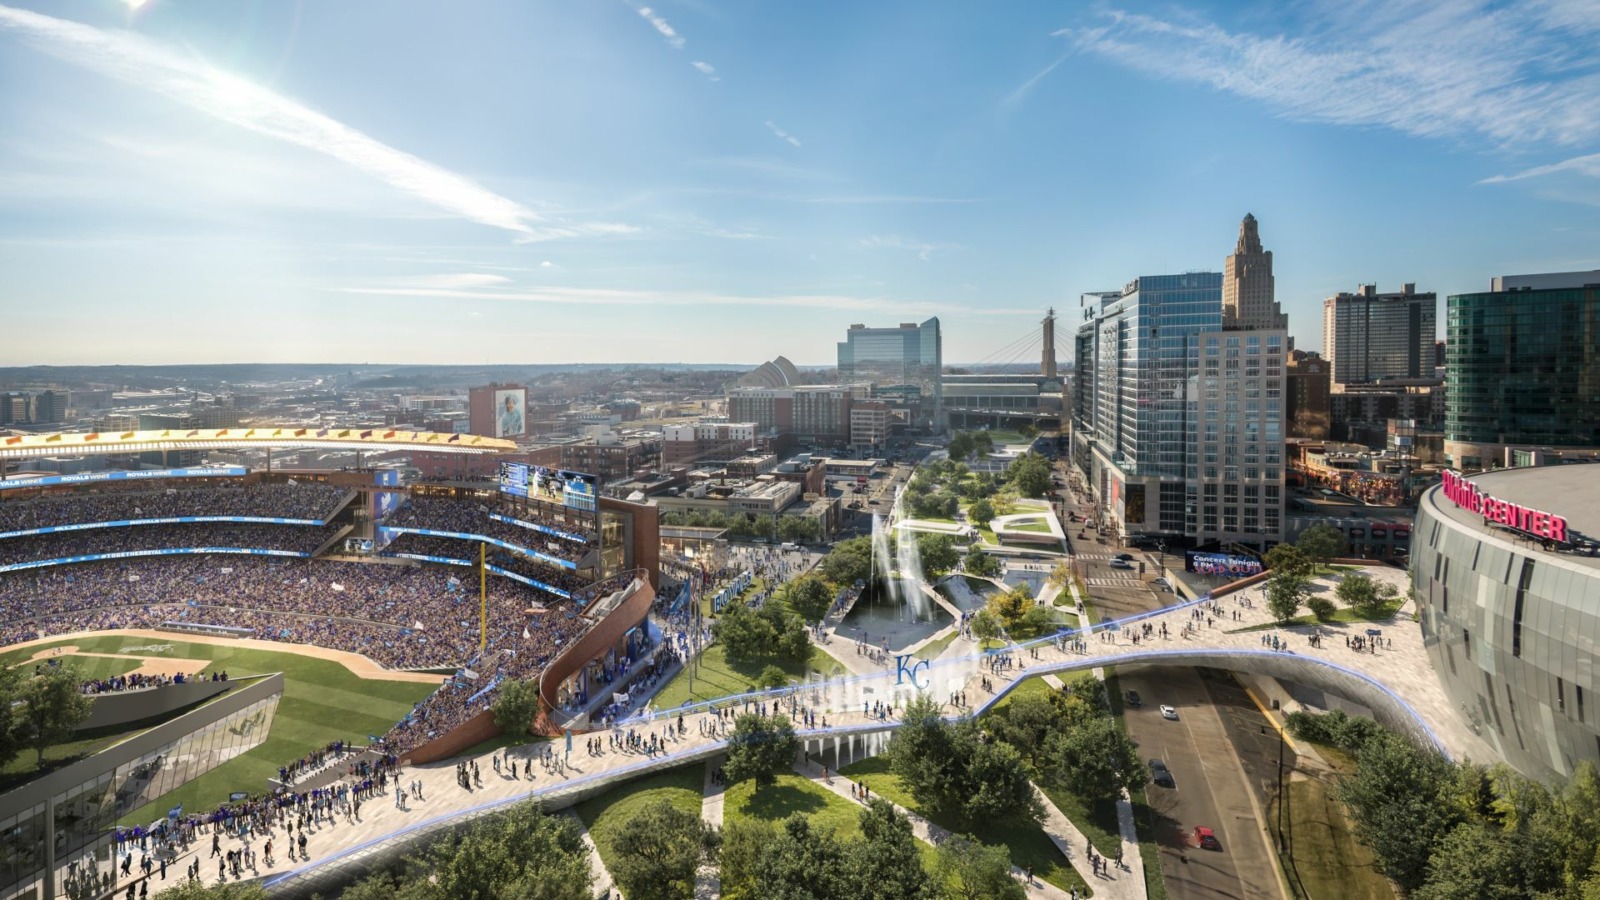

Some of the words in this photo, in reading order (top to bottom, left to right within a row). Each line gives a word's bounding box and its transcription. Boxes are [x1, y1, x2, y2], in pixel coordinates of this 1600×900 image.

[1483, 496, 1569, 543] CENTER
[1193, 555, 1226, 563] Concert
[1228, 558, 1261, 567] Tonight
[894, 653, 930, 690] KC
